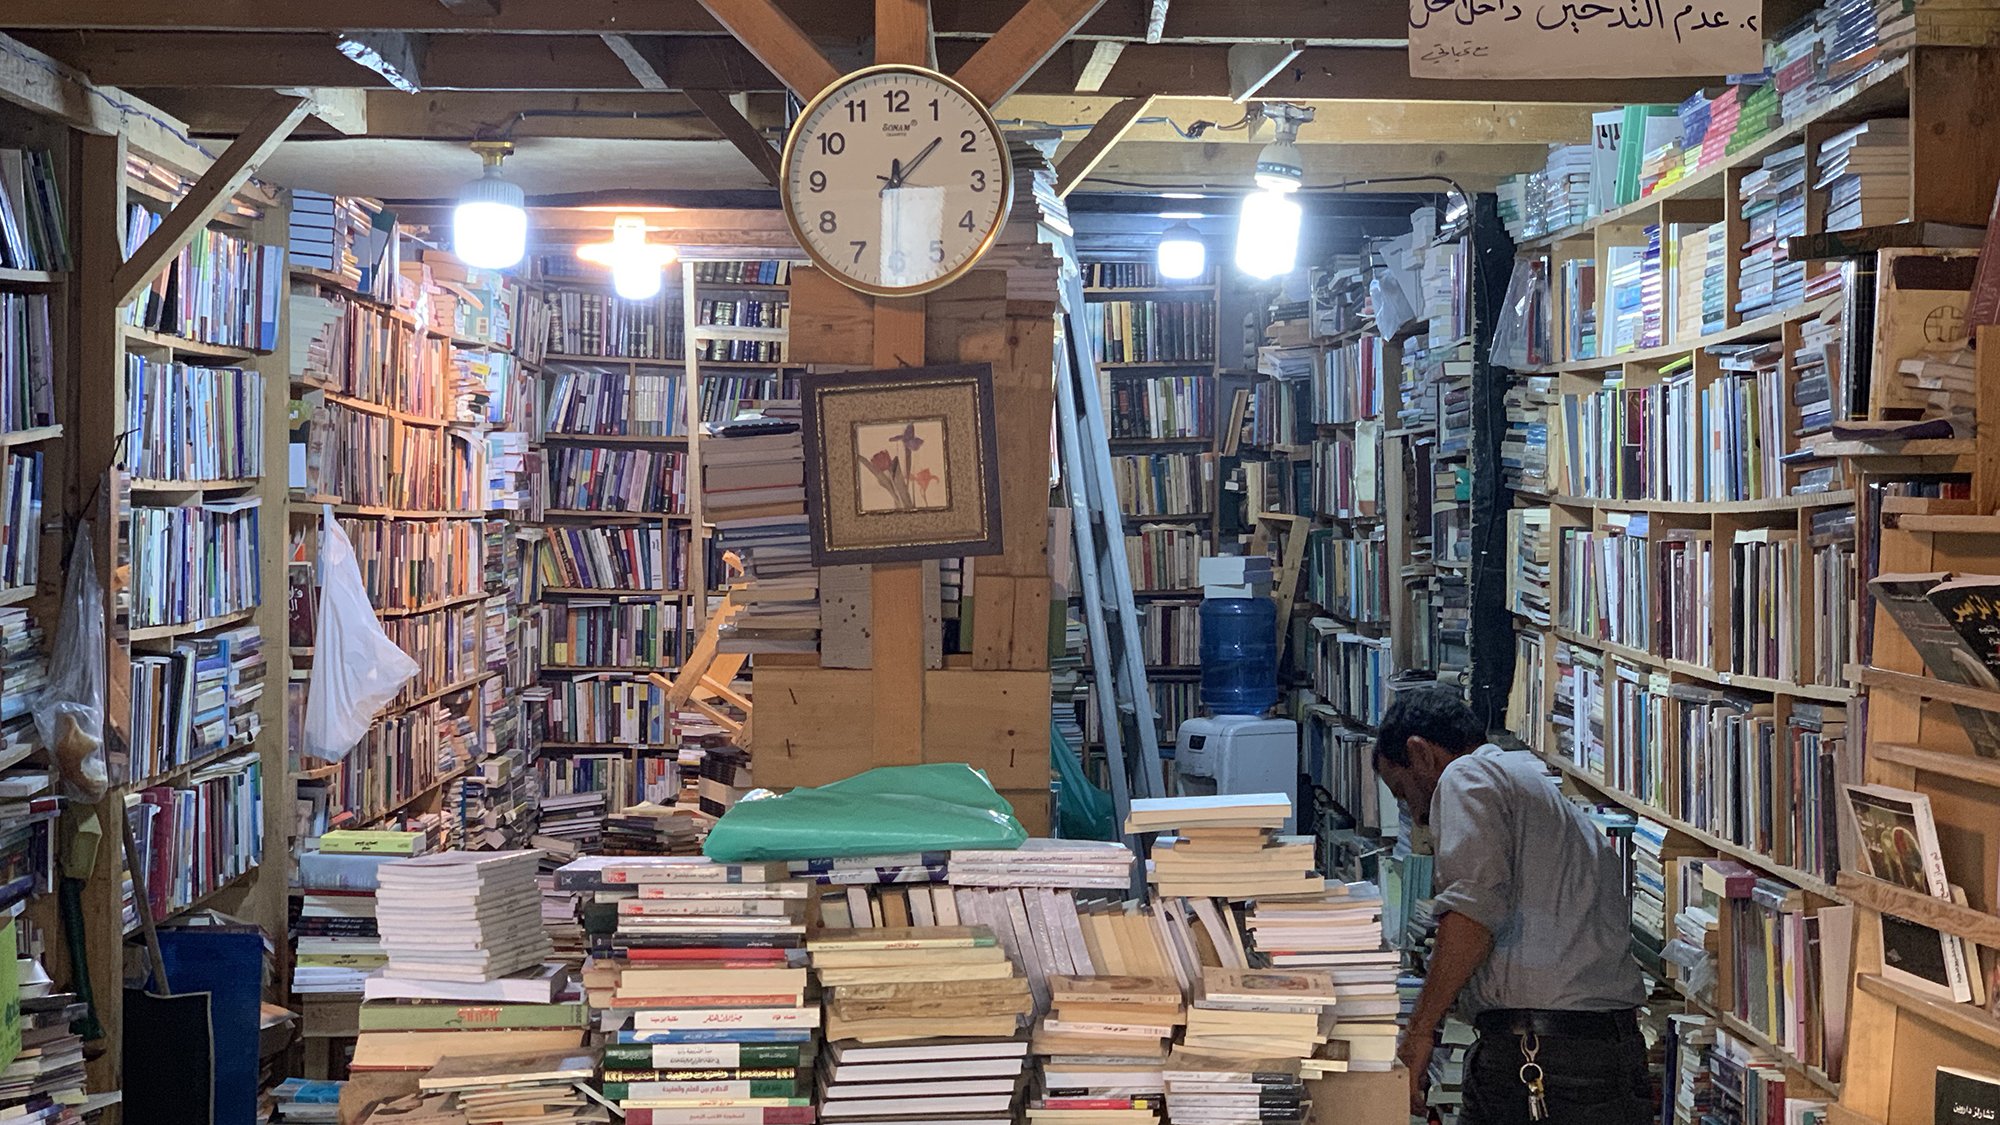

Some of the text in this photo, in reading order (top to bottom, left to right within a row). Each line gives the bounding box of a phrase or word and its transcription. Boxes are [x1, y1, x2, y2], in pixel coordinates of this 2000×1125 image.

[1455, 0, 1523, 25] دخل
[1673, 4, 1730, 44] عدم
[845, 100, 867, 123] 11
[883, 90, 910, 113] 12
[928, 98, 940, 122] 1
[816, 132, 846, 155] 10
[960, 130, 977, 153] 2
[809, 170, 827, 193] 9
[970, 169, 986, 192] 3
[819, 210, 837, 234] 8
[958, 210, 976, 233] 4
[849, 241, 867, 264] 7
[929, 240, 945, 264] 5
[1953, 1102, 1995, 1121] تشارلز داروين
